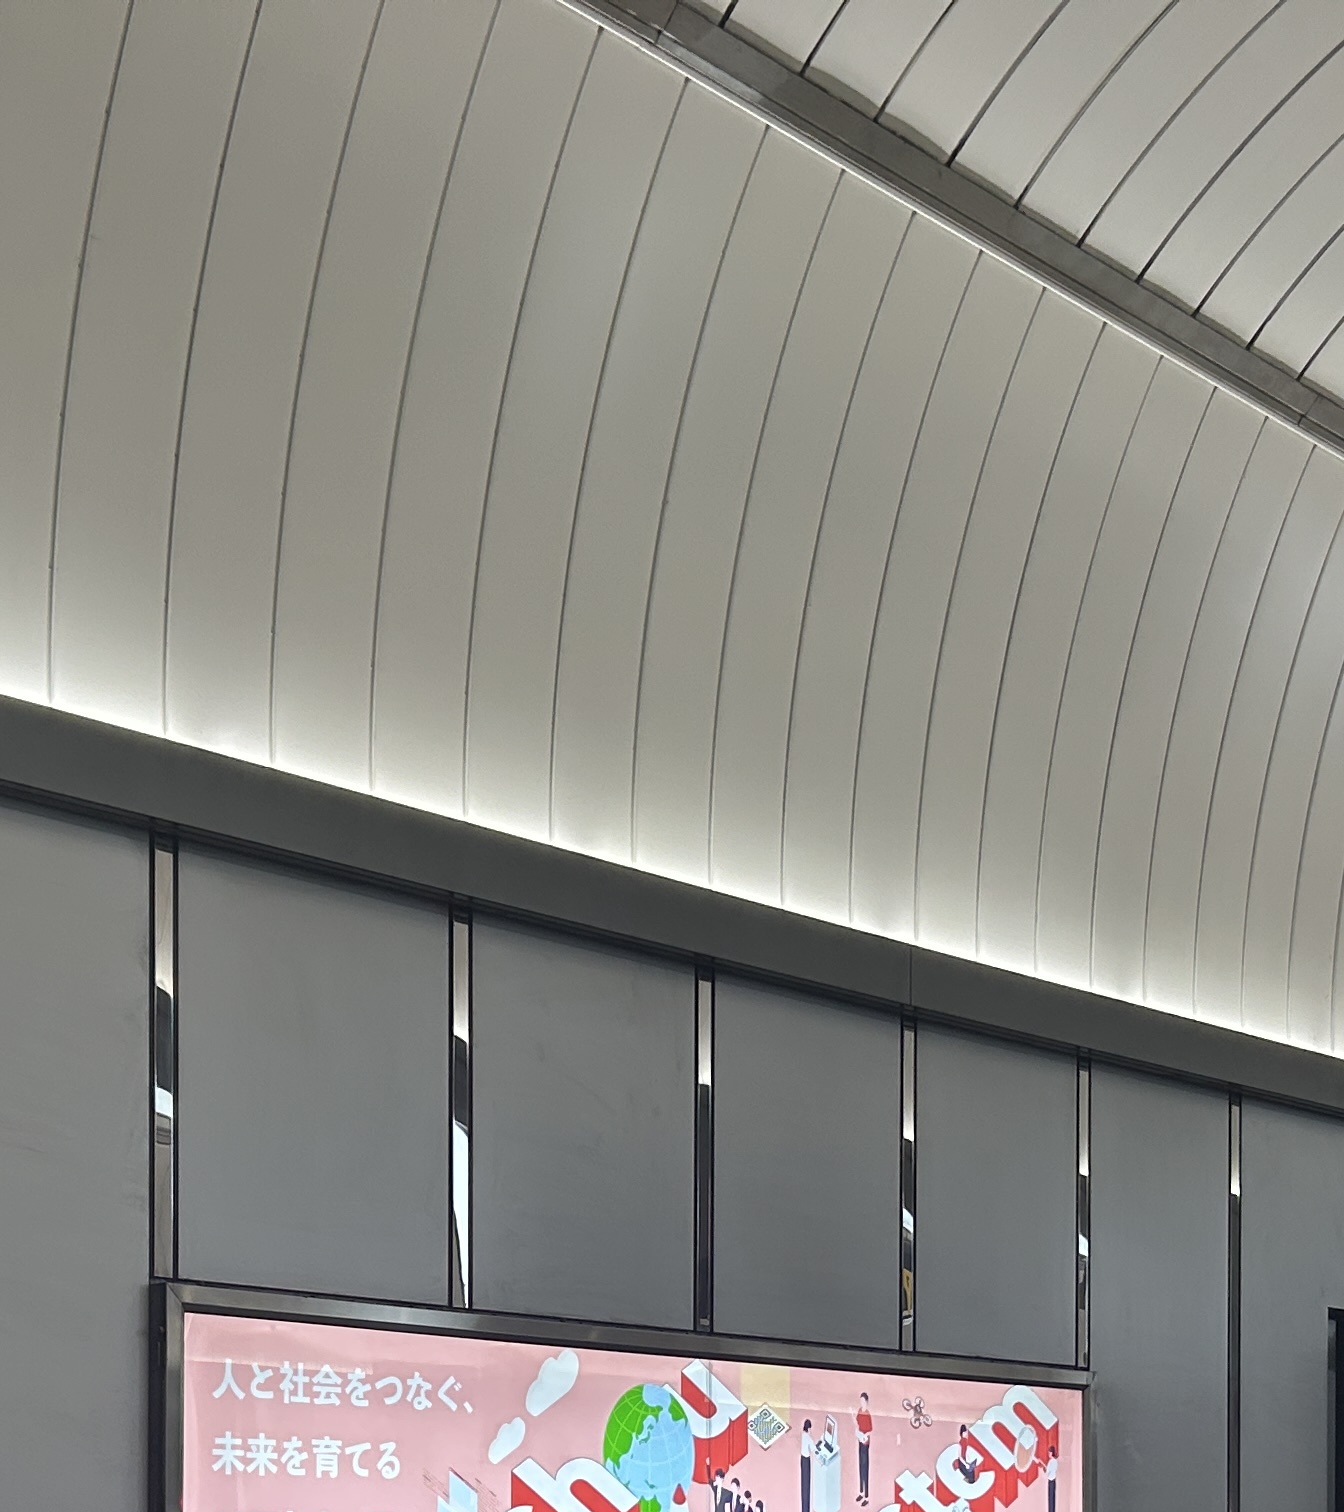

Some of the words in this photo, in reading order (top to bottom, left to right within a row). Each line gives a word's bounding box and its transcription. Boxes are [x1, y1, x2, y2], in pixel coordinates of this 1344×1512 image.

[212, 1358, 473, 1413] 人と社会をつなぐ、
[211, 1431, 401, 1480] 未来を育てる
